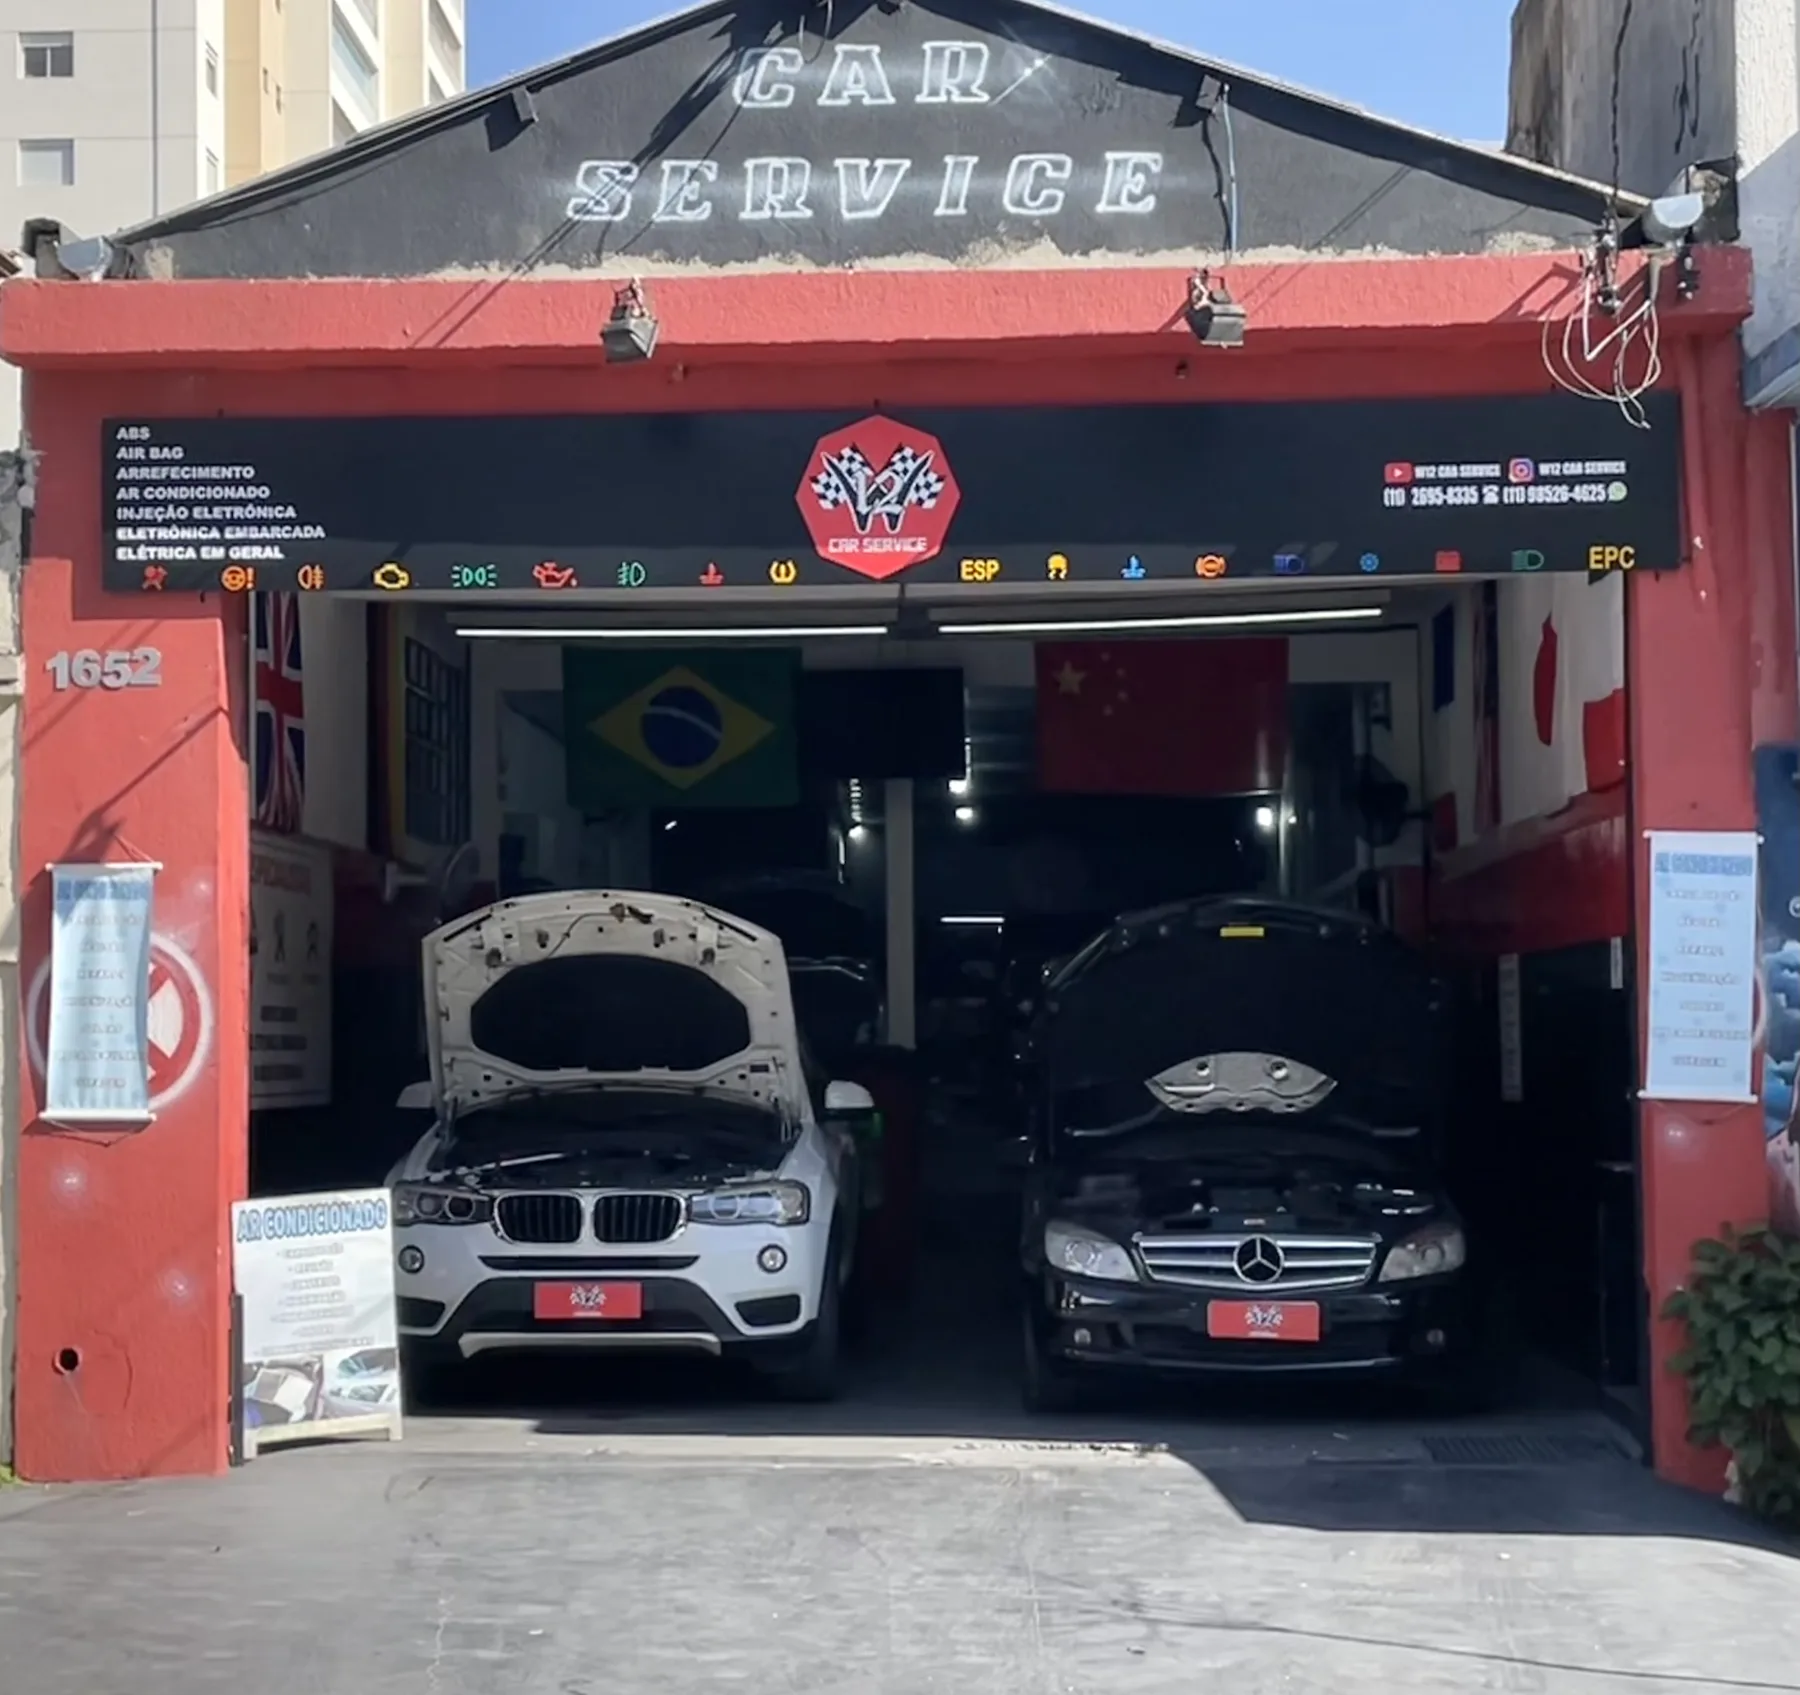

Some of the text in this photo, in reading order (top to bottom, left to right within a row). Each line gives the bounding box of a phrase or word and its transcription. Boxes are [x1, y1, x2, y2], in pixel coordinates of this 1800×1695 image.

[733, 41, 991, 108] CAR
[566, 150, 1163, 221] SERVICE
[116, 426, 151, 440] ABS
[116, 446, 185, 460] AIR BAG
[116, 466, 256, 480] ARREFECIMENTO
[116, 485, 271, 500] AR CONDICIONADO
[117, 503, 189, 522] INJEÇÃO
[116, 525, 326, 541] ELETRÔNICA EMBARCADA
[116, 544, 285, 561] ELÉTRICA EM GERAL
[828, 536, 927, 553] CAR SERVICE
[1589, 546, 1636, 570] EPC
[961, 560, 999, 580] ESP
[44, 647, 162, 691] 1652
[237, 1197, 388, 1242] AR CONDICIONADO
